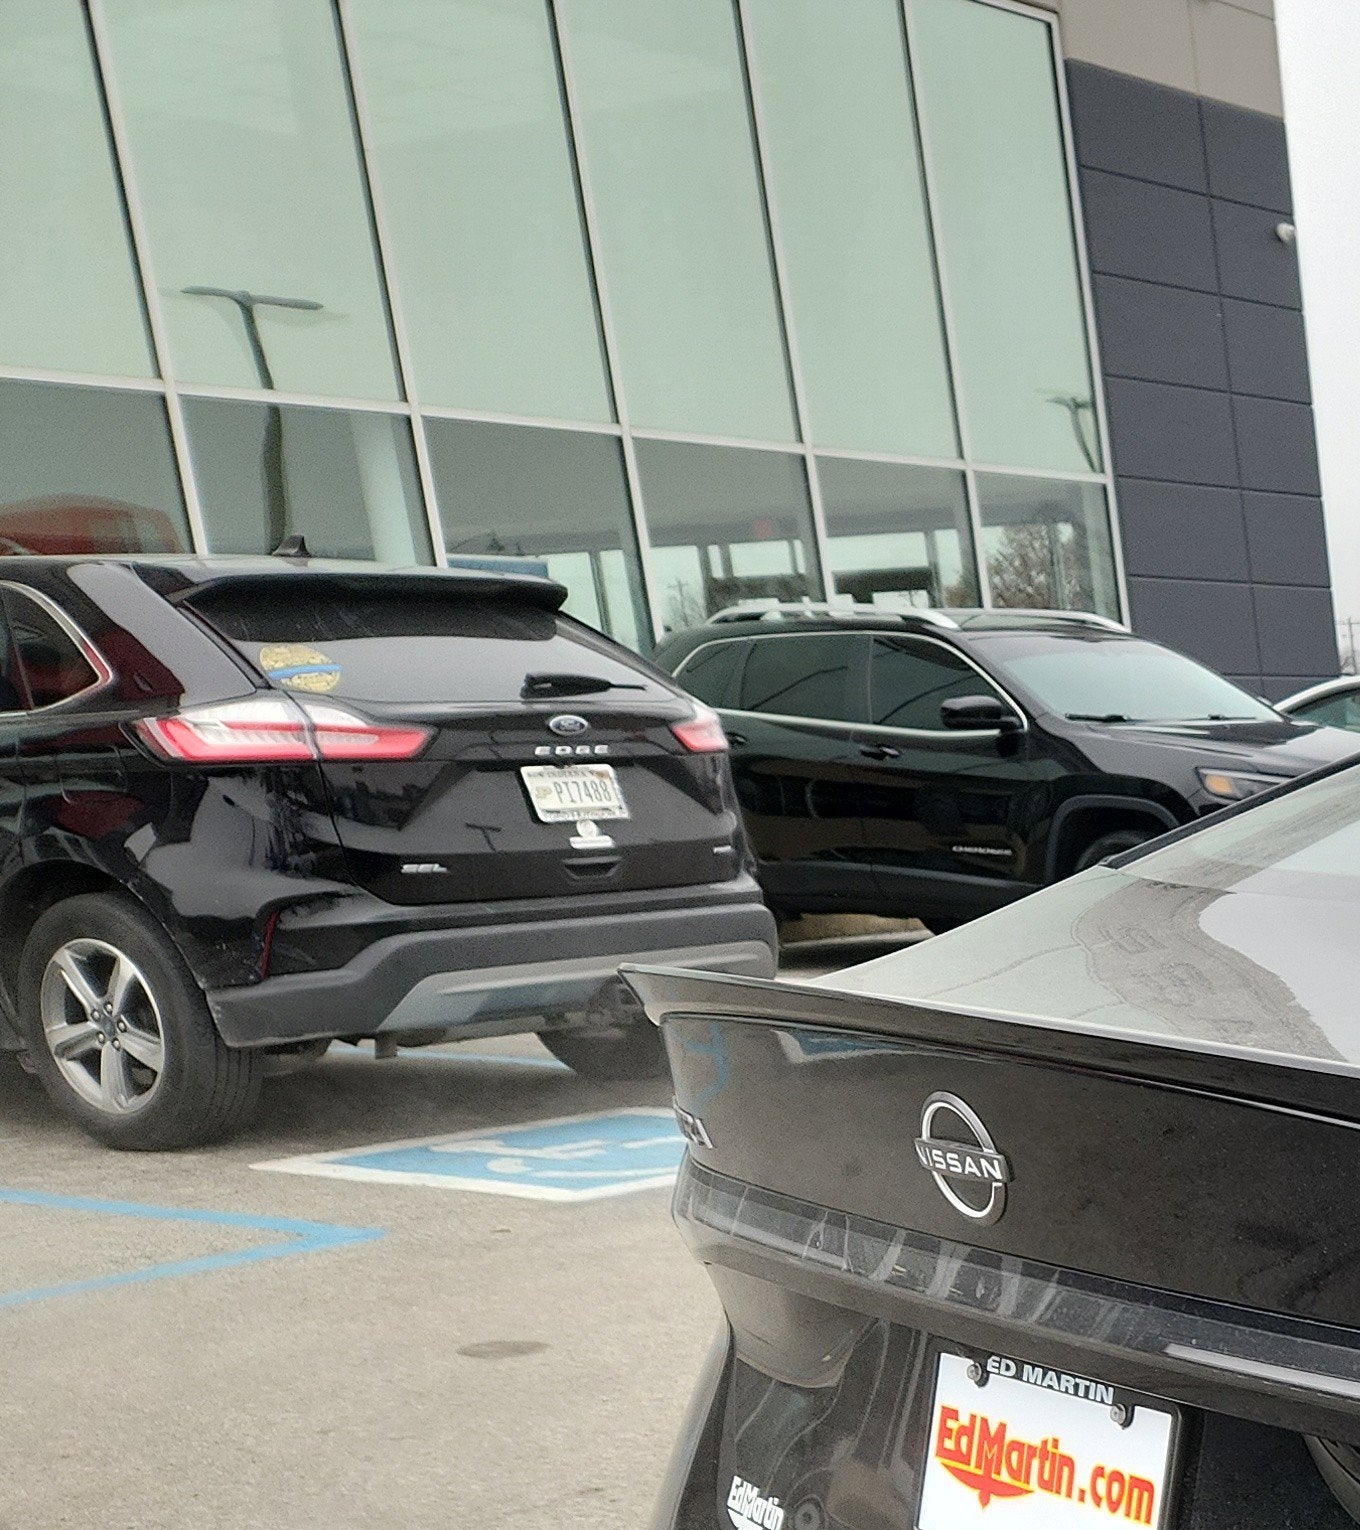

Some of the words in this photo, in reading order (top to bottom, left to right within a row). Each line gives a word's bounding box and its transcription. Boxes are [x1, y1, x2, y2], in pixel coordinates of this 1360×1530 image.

[914, 1143, 1003, 1180] NISSAN
[986, 1356, 1017, 1377] ED
[1022, 1364, 1116, 1405] MARTIN
[934, 1404, 1155, 1526] EdMartin.com
